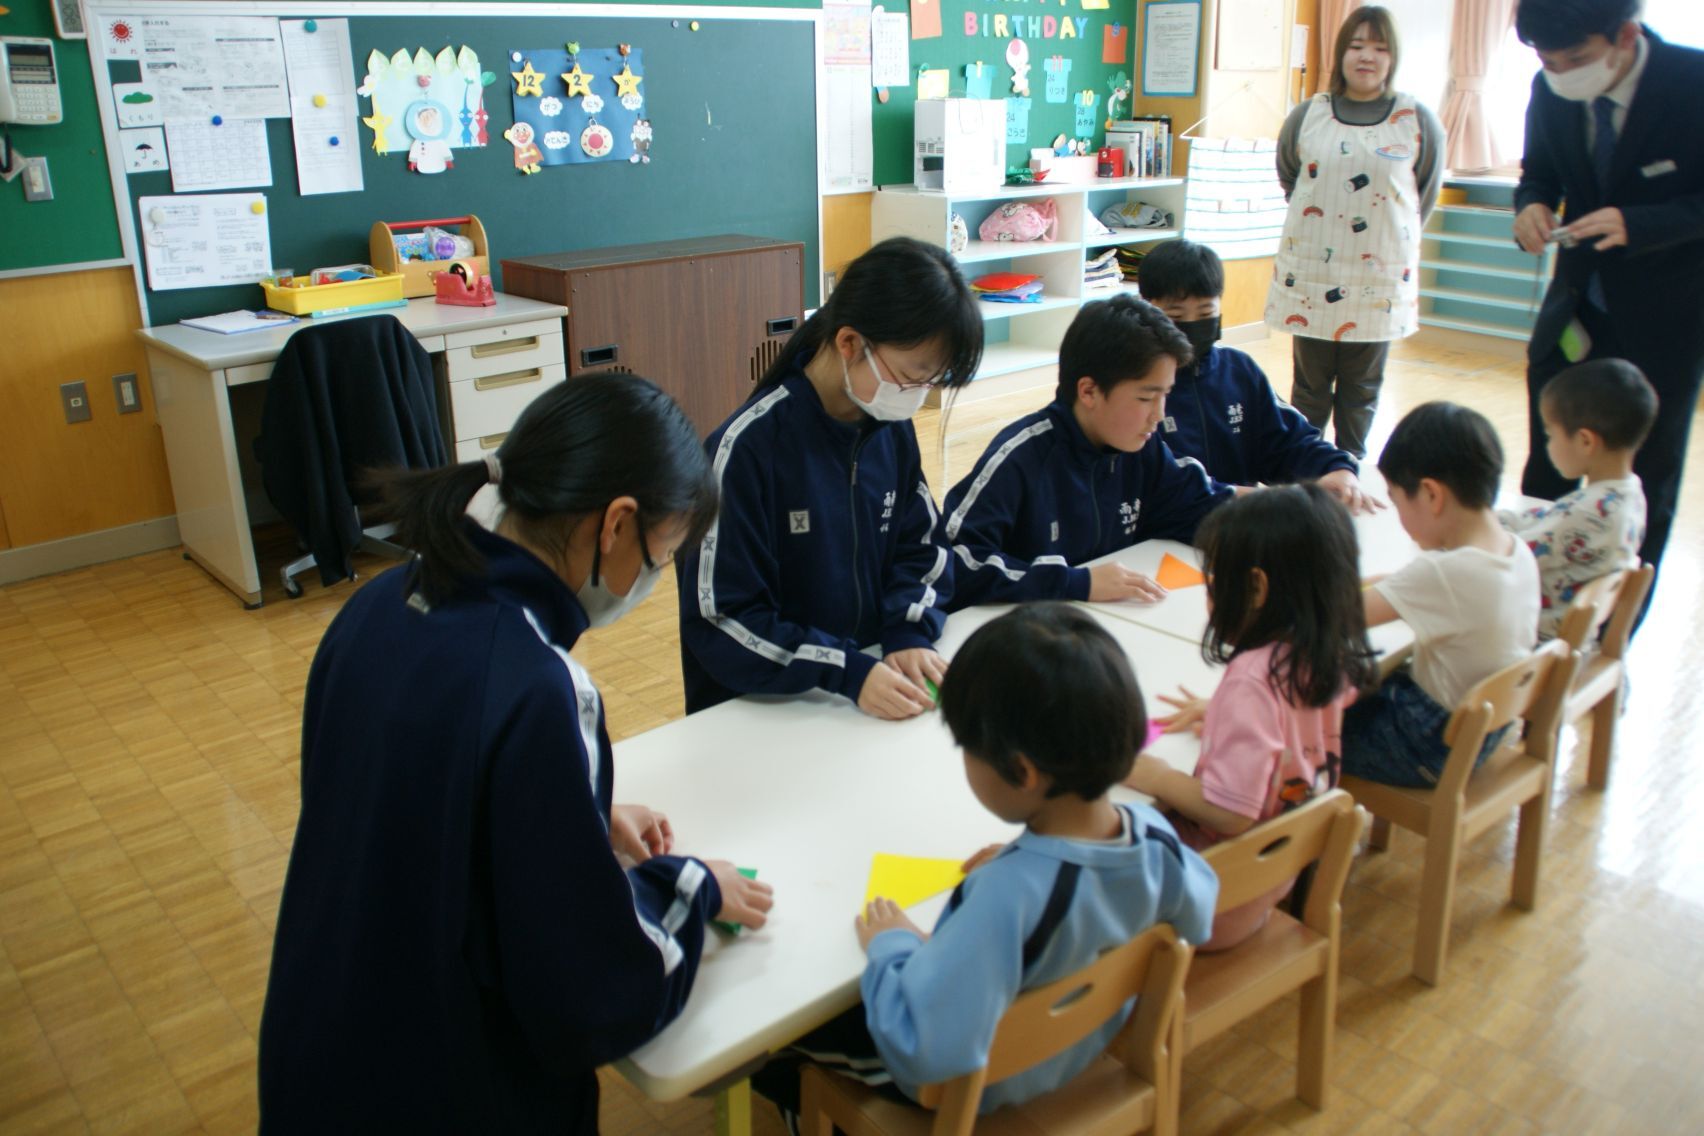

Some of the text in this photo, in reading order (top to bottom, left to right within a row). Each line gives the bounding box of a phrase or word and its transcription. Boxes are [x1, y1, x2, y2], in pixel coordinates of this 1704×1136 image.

[964, 11, 1088, 39] BIRTHDAY
[522, 75, 535, 87] 12
[573, 74, 582, 86] 2
[1082, 90, 1094, 106] 10
